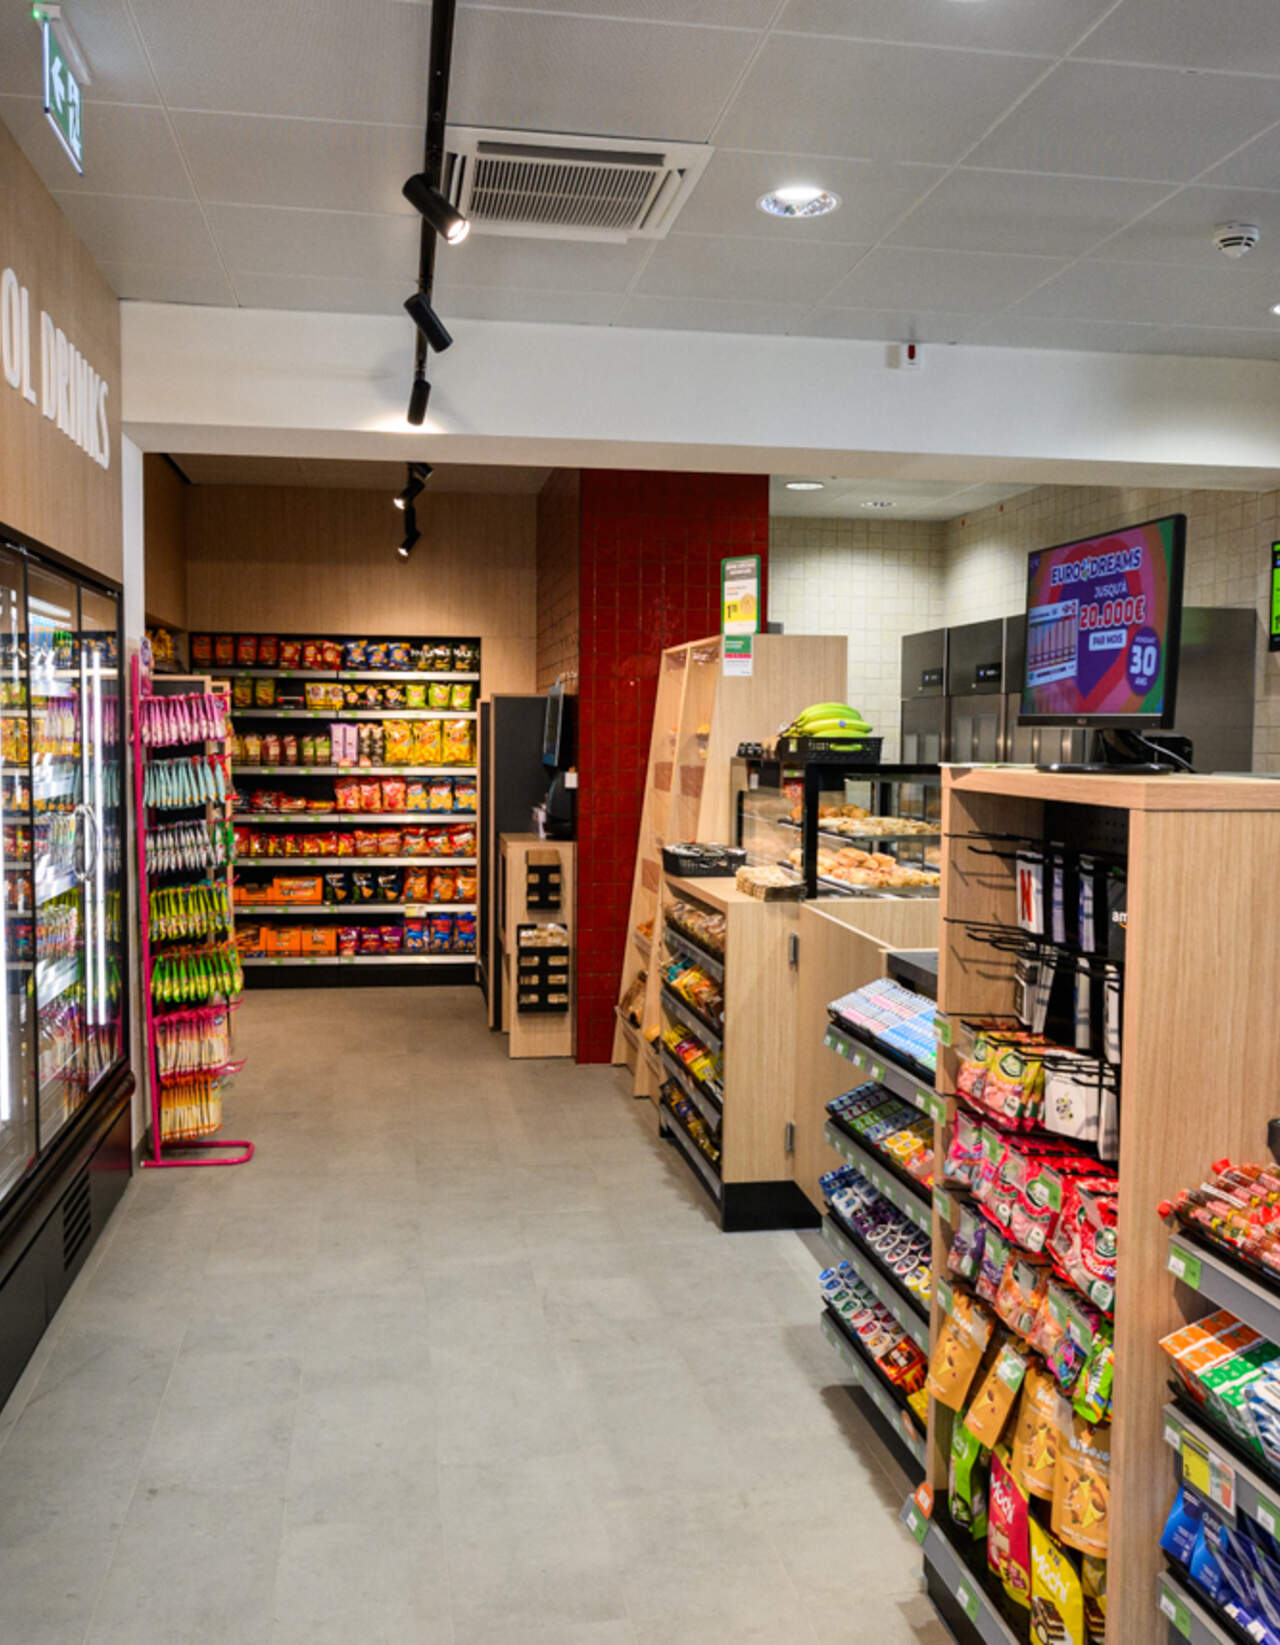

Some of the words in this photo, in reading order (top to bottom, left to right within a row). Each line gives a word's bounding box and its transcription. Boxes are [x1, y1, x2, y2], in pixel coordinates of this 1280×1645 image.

[40, 310, 110, 470] DRINKS
[1050, 560, 1081, 587] EURO
[1089, 546, 1142, 578] DREAMS
[1130, 645, 1157, 676] 30
